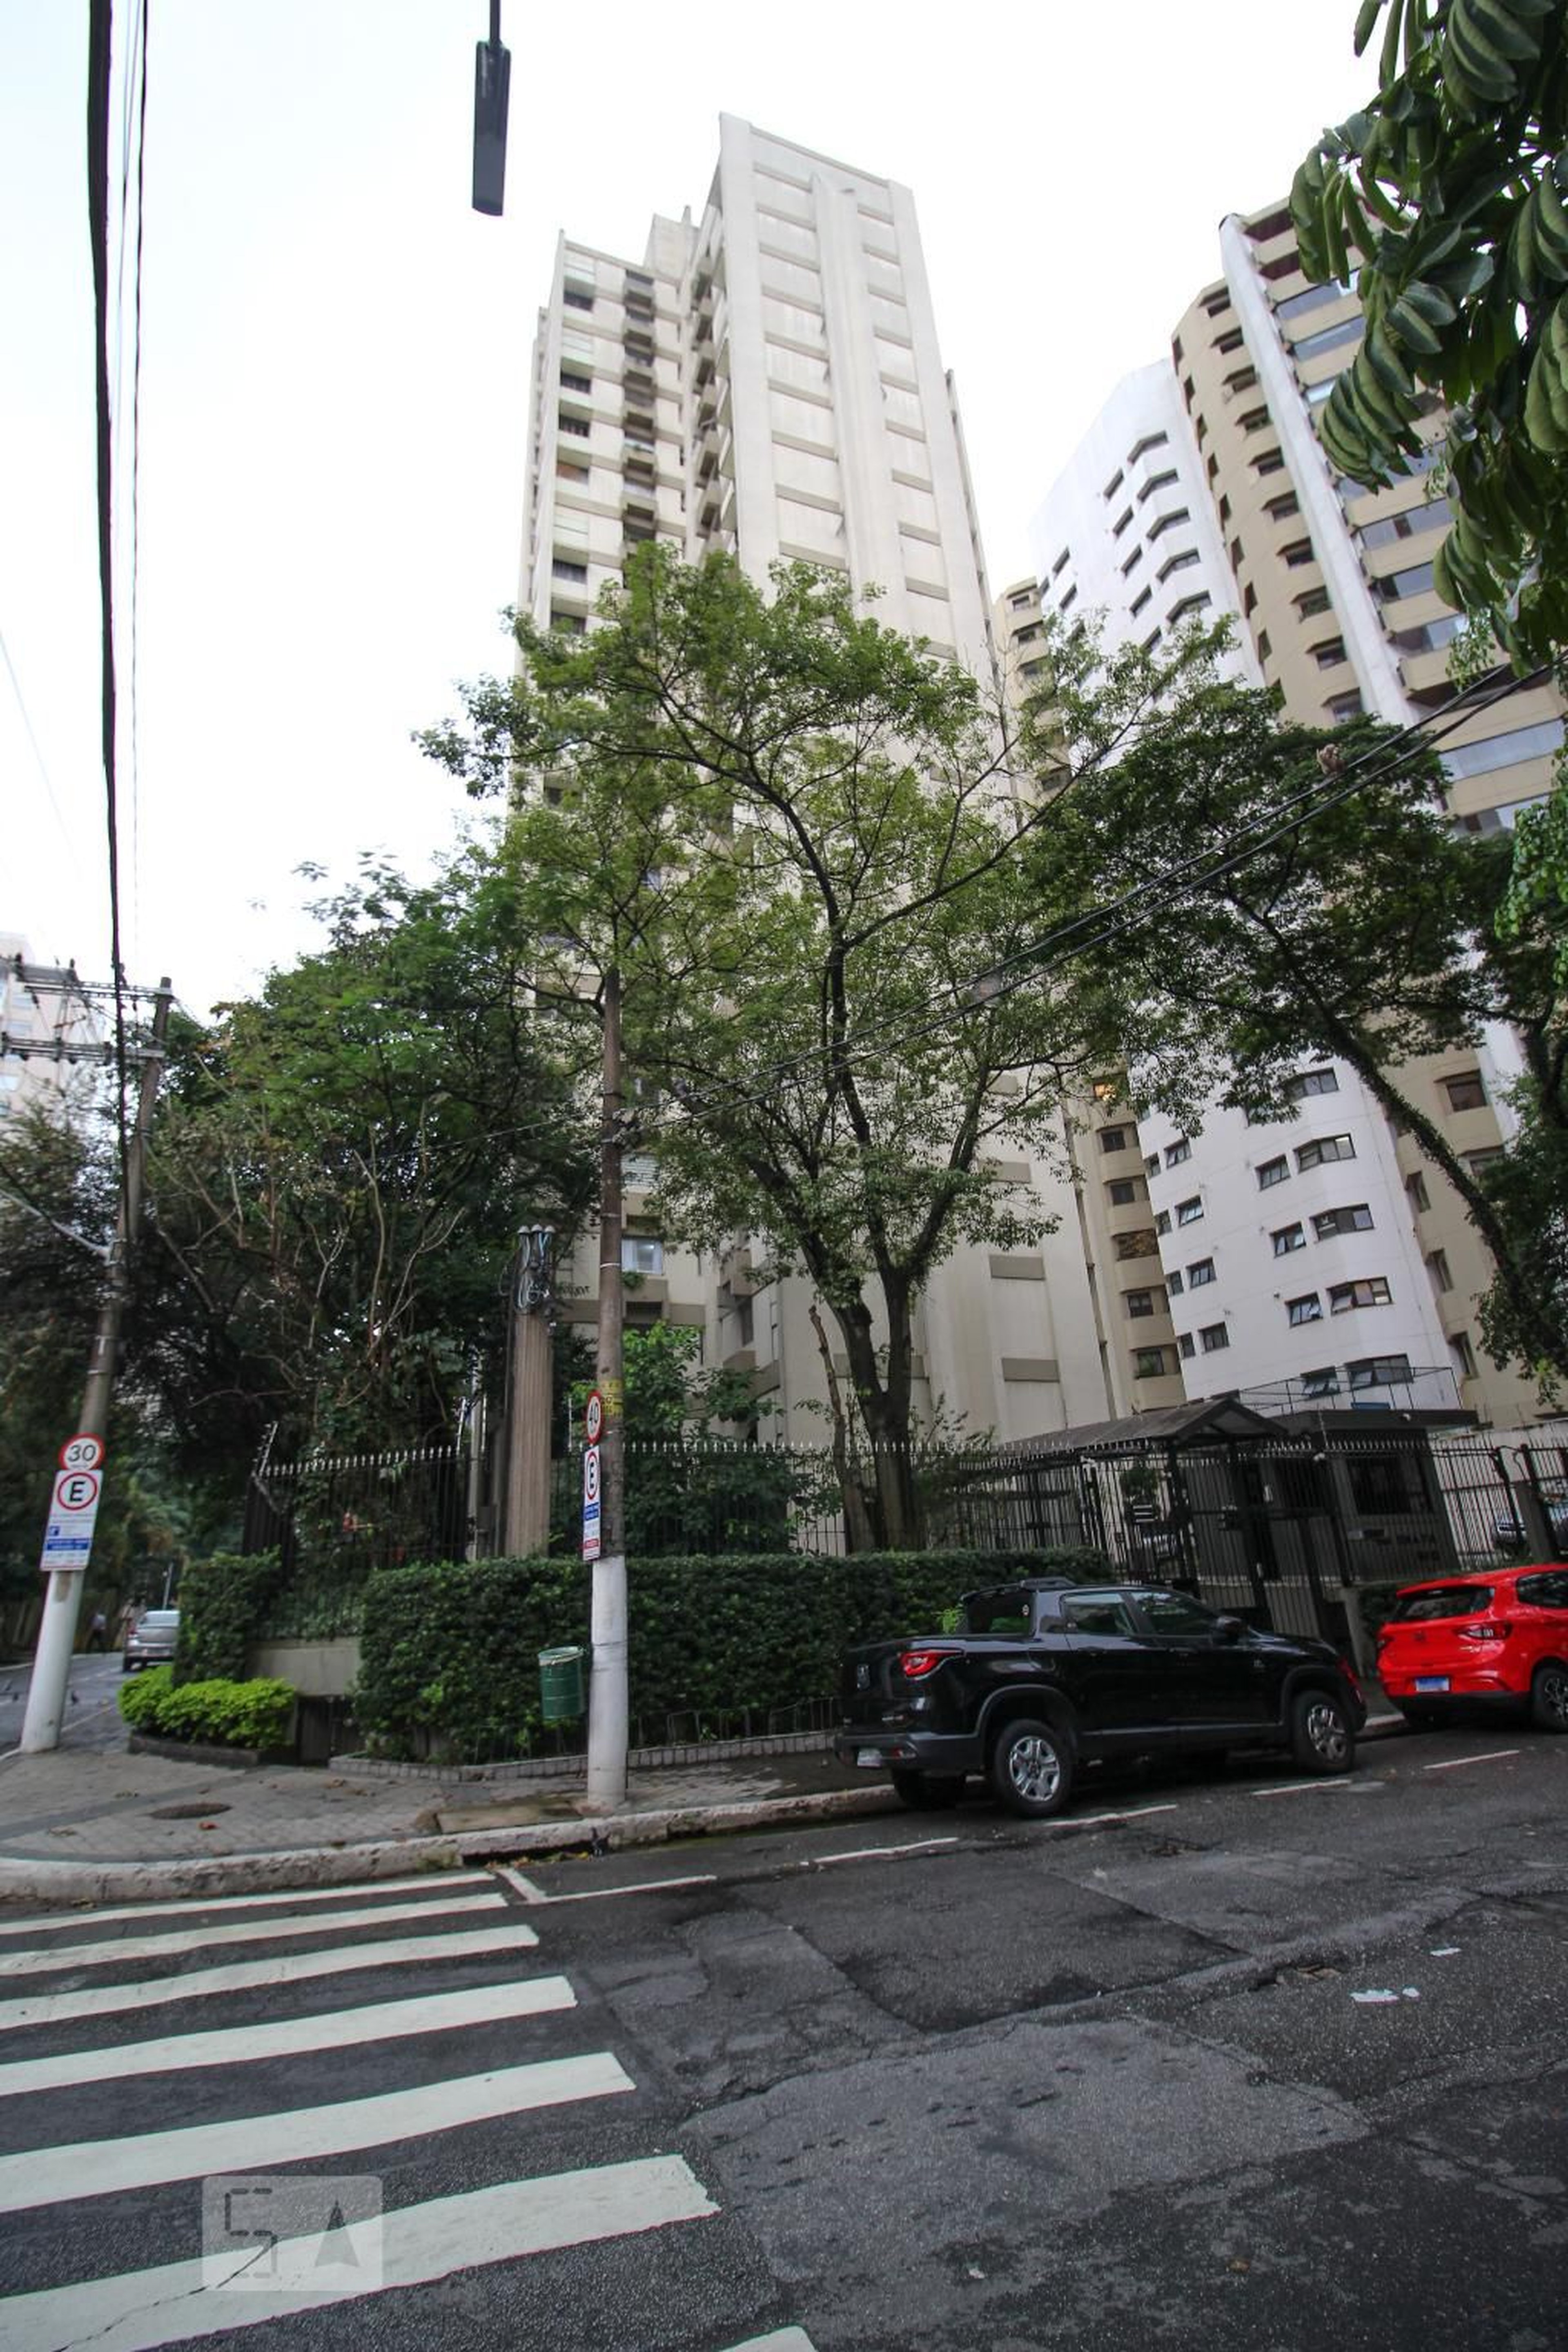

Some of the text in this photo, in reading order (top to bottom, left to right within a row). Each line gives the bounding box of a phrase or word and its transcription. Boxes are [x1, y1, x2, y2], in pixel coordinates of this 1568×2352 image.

[589, 1402, 599, 1425] 40
[68, 1445, 96, 1462] 30
[590, 1462, 594, 1488] E
[70, 1481, 86, 1501] E
